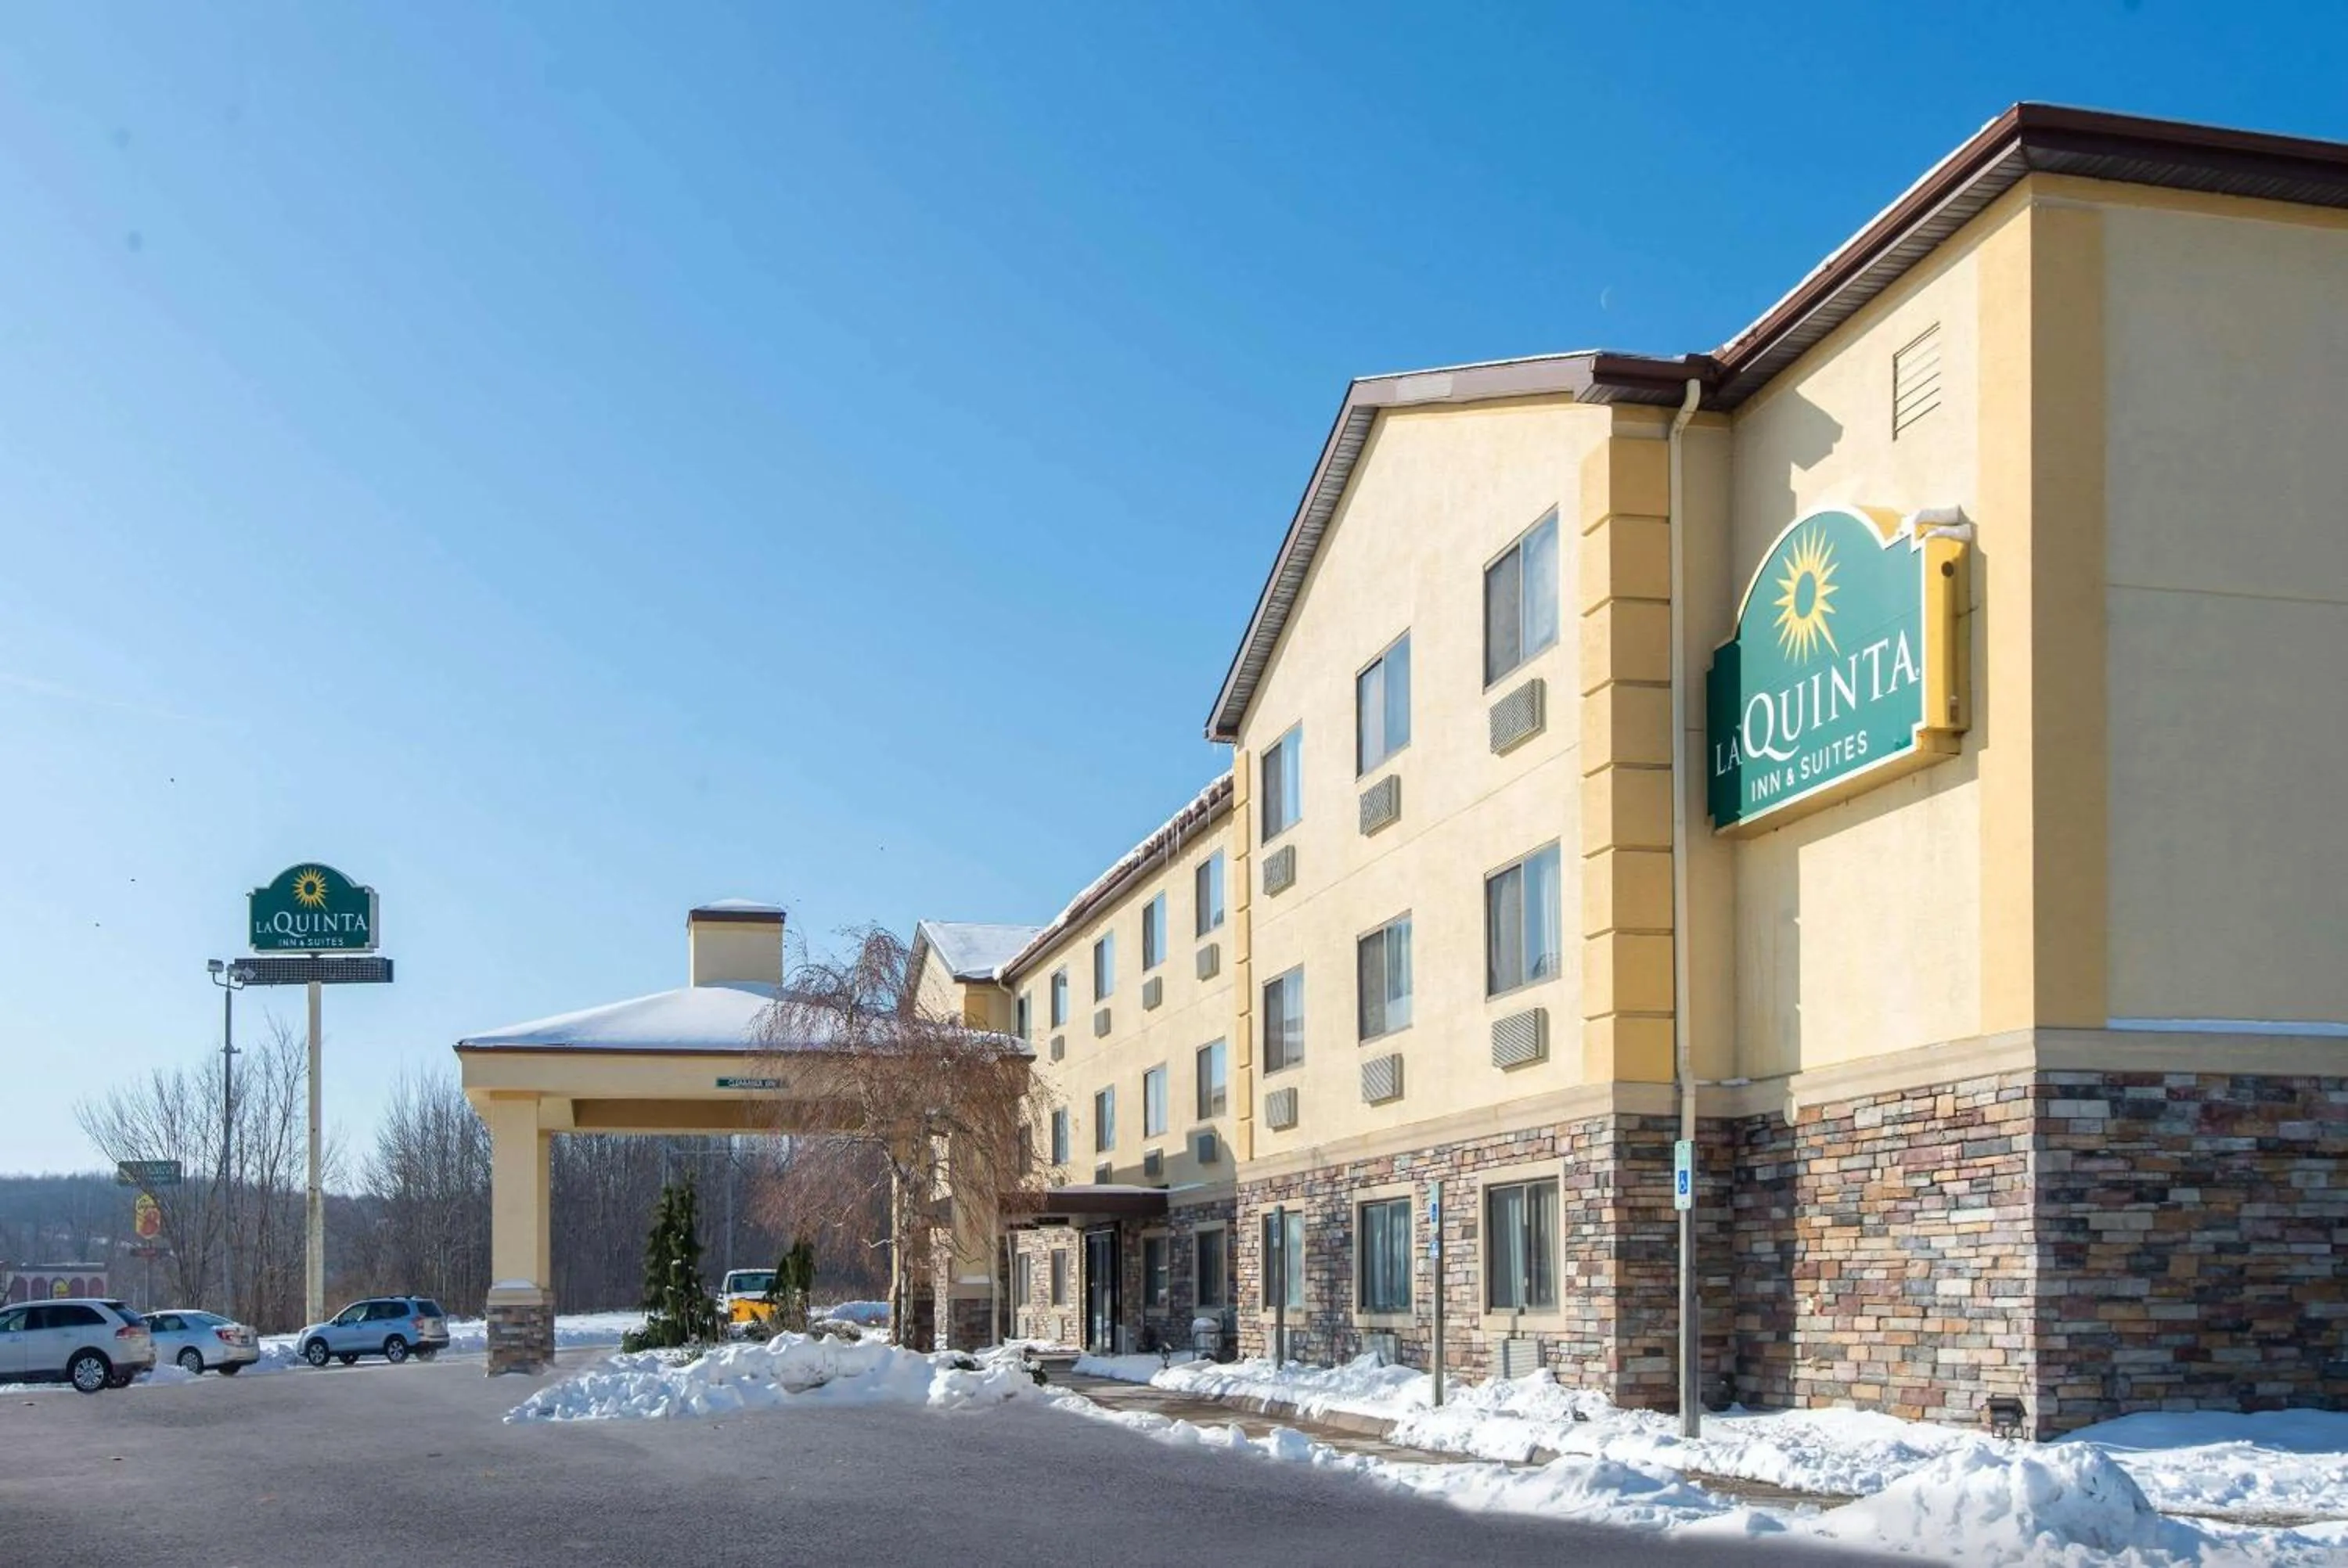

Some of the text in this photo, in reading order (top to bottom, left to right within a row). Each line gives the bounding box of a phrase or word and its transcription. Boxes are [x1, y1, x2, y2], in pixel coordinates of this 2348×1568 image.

[1716, 628, 1919, 777] LA QUINTA
[1751, 729, 1868, 802] INN & SUITES
[255, 911, 368, 938] LA QUINTA
[278, 938, 297, 947] INN
[307, 938, 345, 947] SUITES
